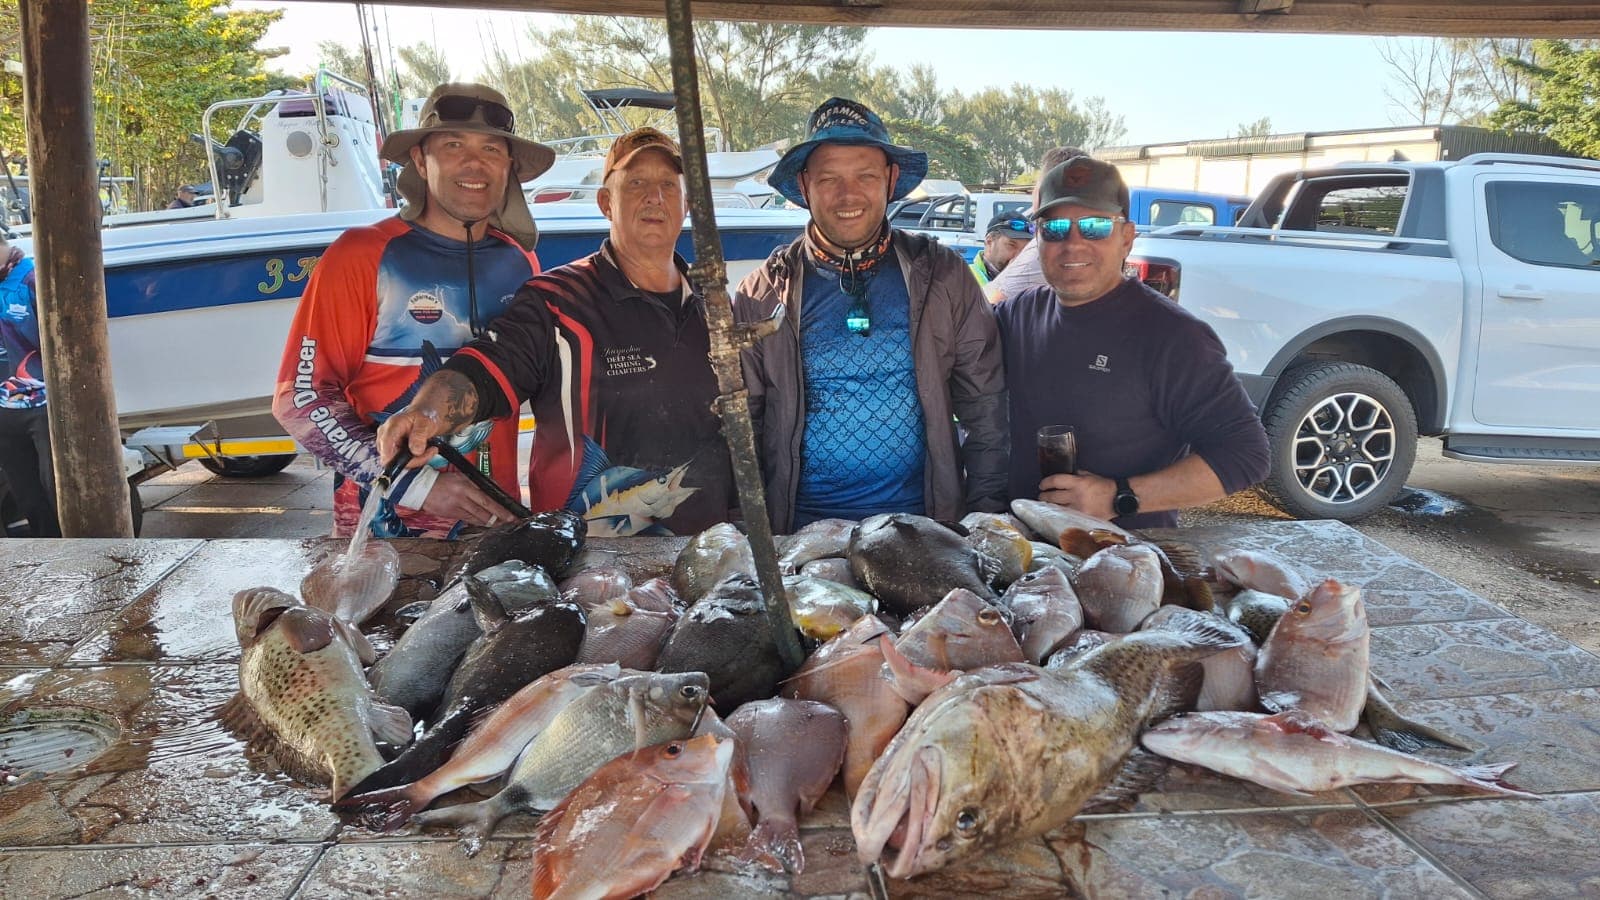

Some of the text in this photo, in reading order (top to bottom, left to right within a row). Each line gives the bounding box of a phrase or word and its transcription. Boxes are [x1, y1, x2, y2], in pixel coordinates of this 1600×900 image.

[257, 258, 284, 294] 3
[606, 354, 641, 364] DEEP SEA
[609, 361, 641, 370] FISHING
[606, 367, 647, 376] CHARTERS
[293, 335, 363, 460] Wave Dncer
